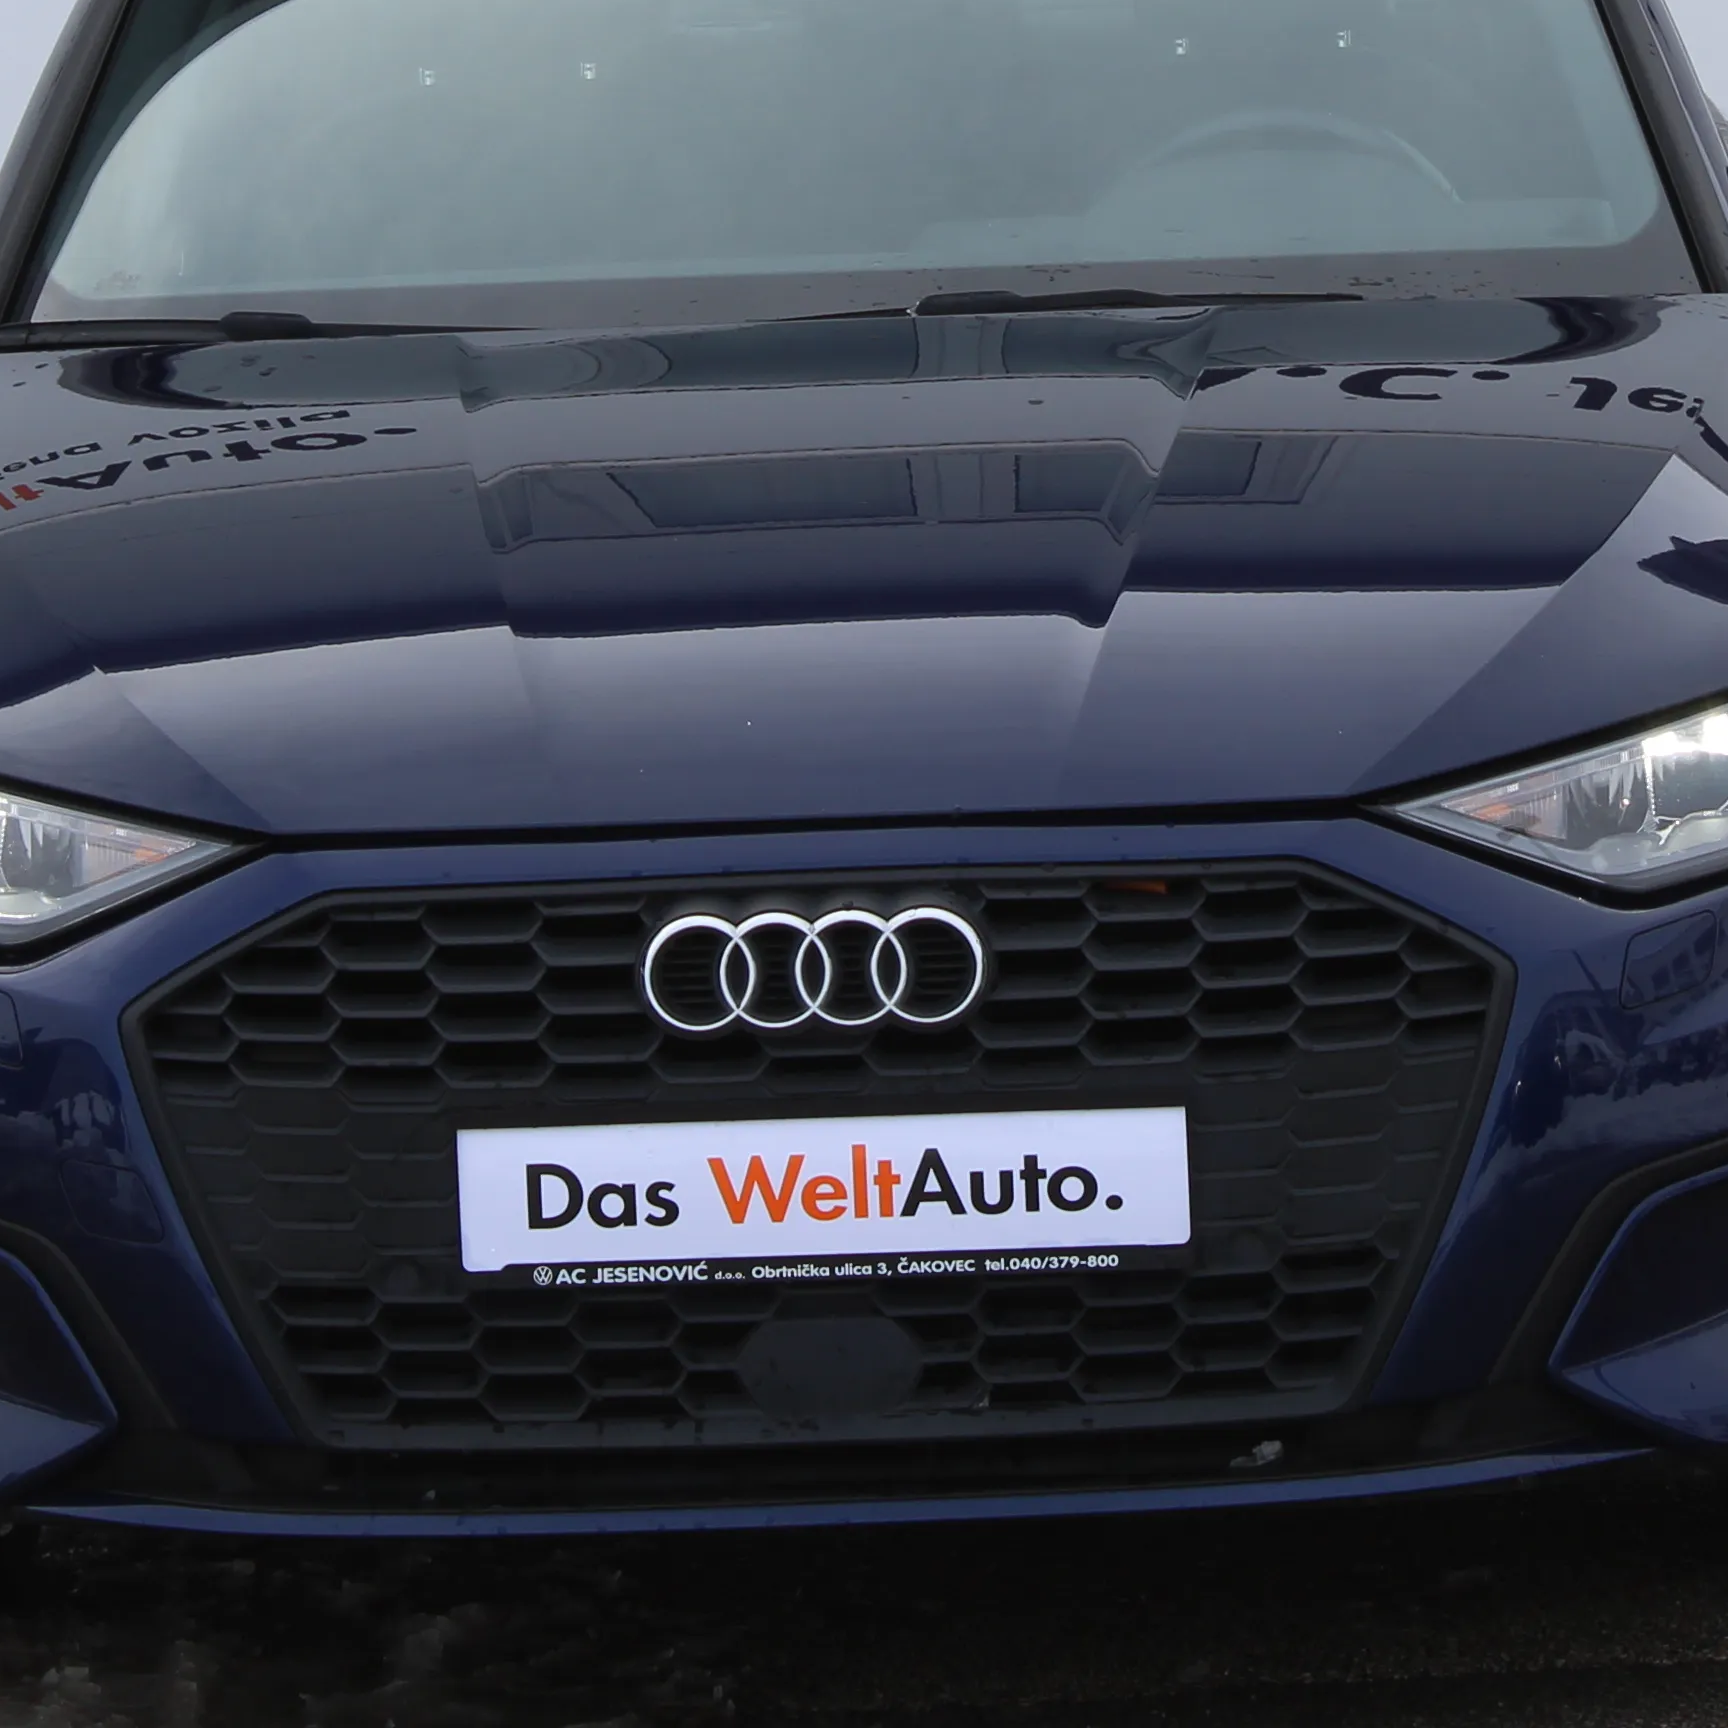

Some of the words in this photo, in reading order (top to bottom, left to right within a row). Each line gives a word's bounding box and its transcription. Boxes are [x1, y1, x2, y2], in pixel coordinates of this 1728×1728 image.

[525, 1163, 680, 1230] Das
[707, 1144, 1124, 1225] WeltAuto.
[555, 1268, 587, 1285] AC
[592, 1260, 709, 1284] JESENOVIĆ
[714, 1270, 746, 1280] d.o.o.
[751, 1263, 830, 1279] Obrtnička
[834, 1262, 873, 1276] ulica
[877, 1262, 893, 1277] 3,
[897, 1256, 976, 1274] ČAKOVEC
[984, 1254, 1119, 1271] tel.040/379-800
